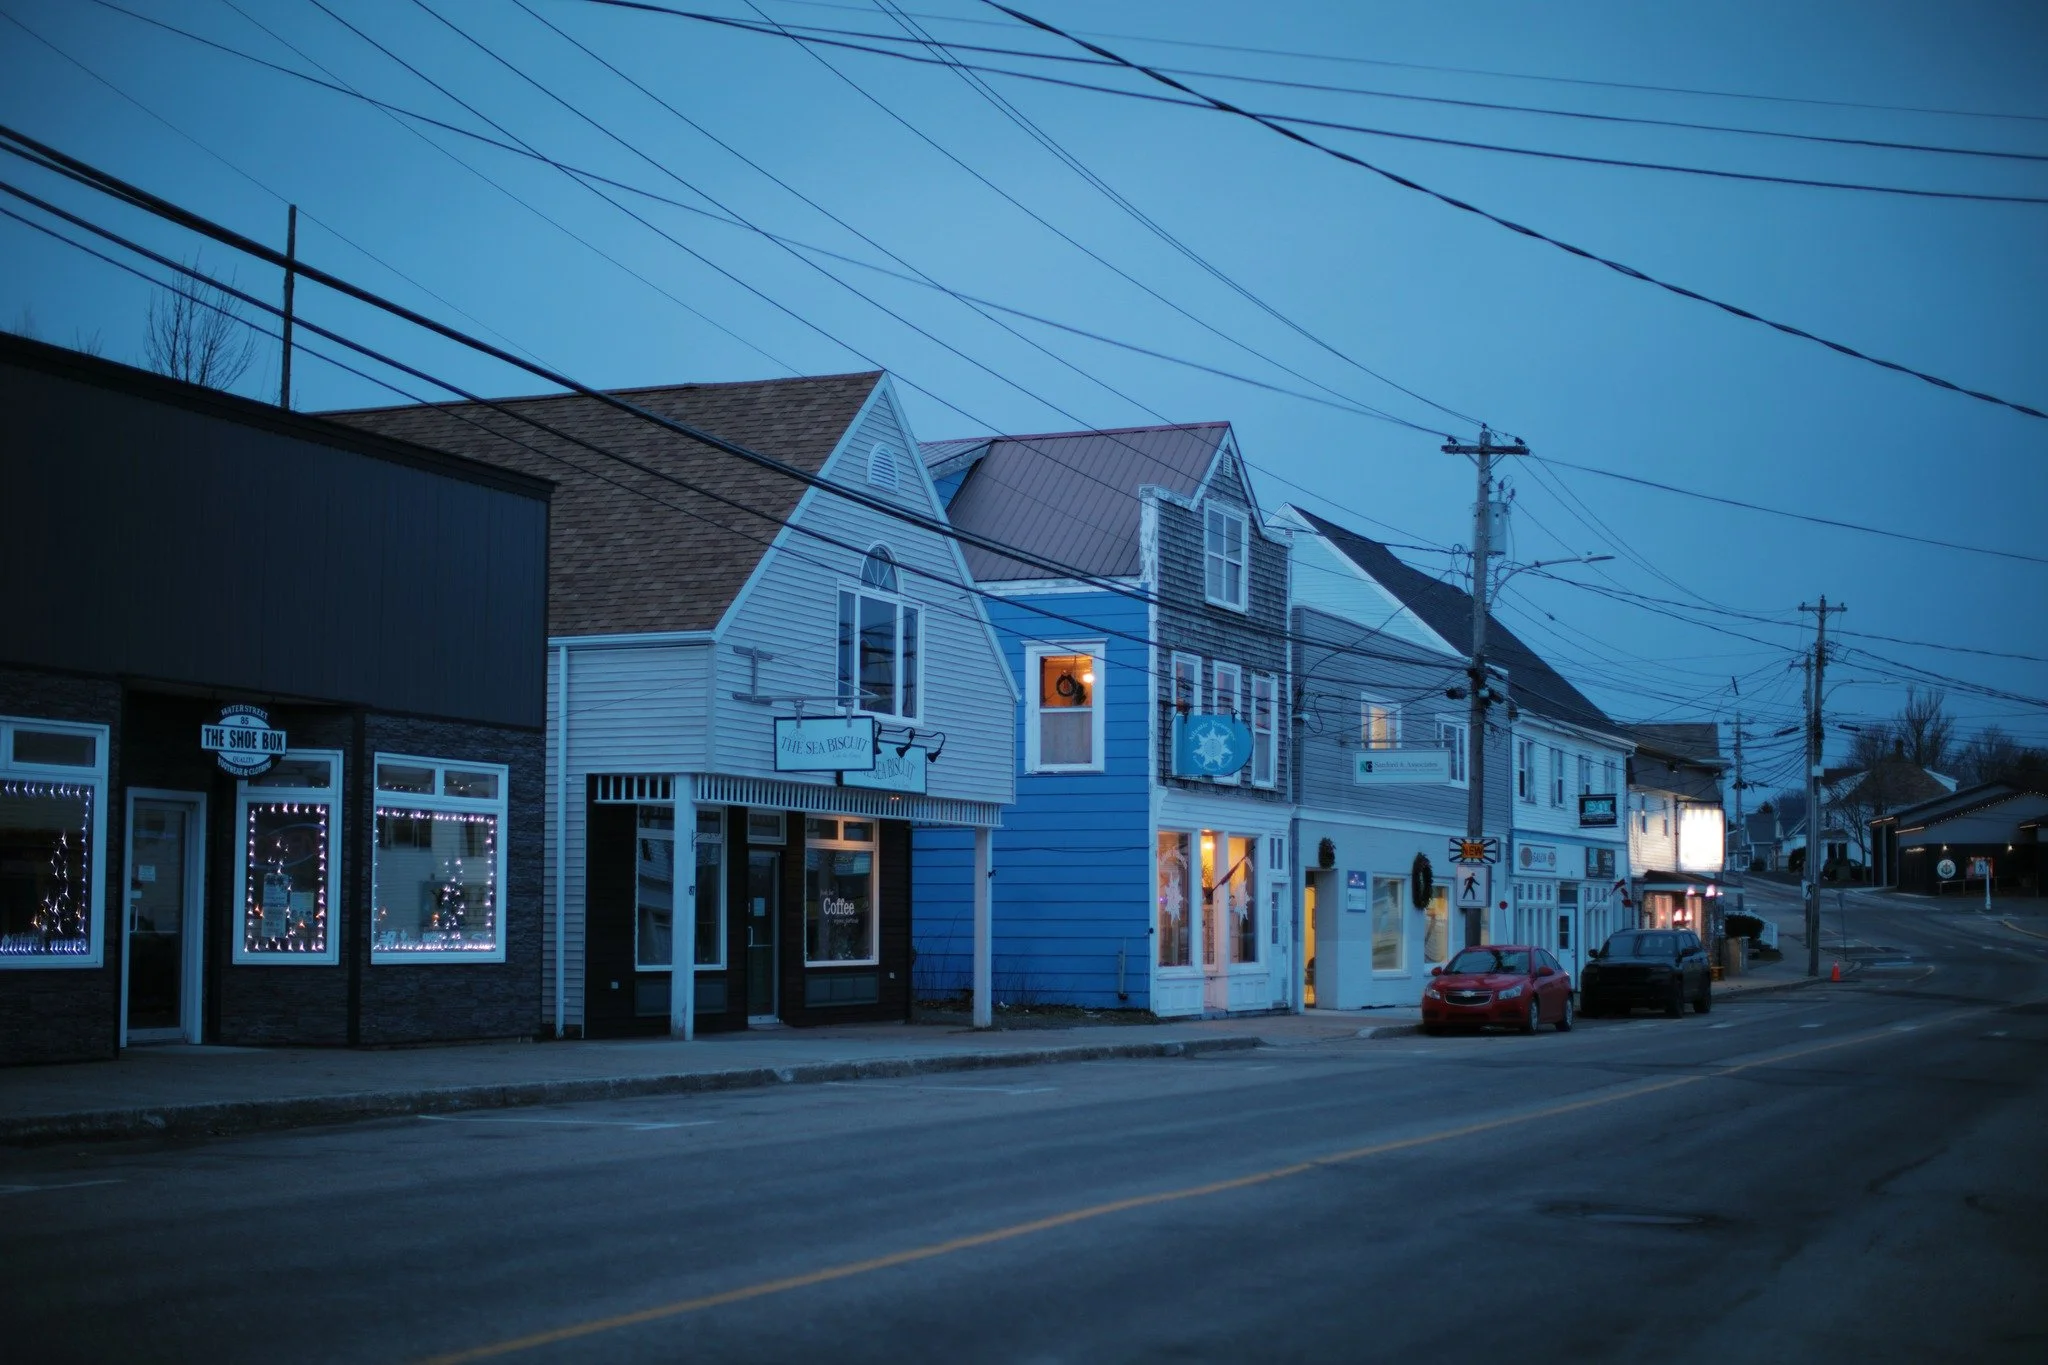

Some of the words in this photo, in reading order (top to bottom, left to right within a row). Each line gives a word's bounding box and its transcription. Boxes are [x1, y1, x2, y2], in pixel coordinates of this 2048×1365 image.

[221, 704, 244, 717] WATER
[244, 704, 268, 720] STREET
[240, 716, 249, 725] 85
[204, 728, 224, 747] THE
[229, 730, 257, 749] SHOE
[262, 732, 283, 751] BOX
[781, 736, 803, 755] THE
[806, 741, 825, 755] SEA
[827, 735, 870, 753] BISCUIT
[232, 755, 255, 764] QUALITY
[887, 756, 916, 781] BISCUIT
[1463, 845, 1483, 857] NEW
[688, 885, 695, 897] 87
[823, 897, 855, 915] Coffee
